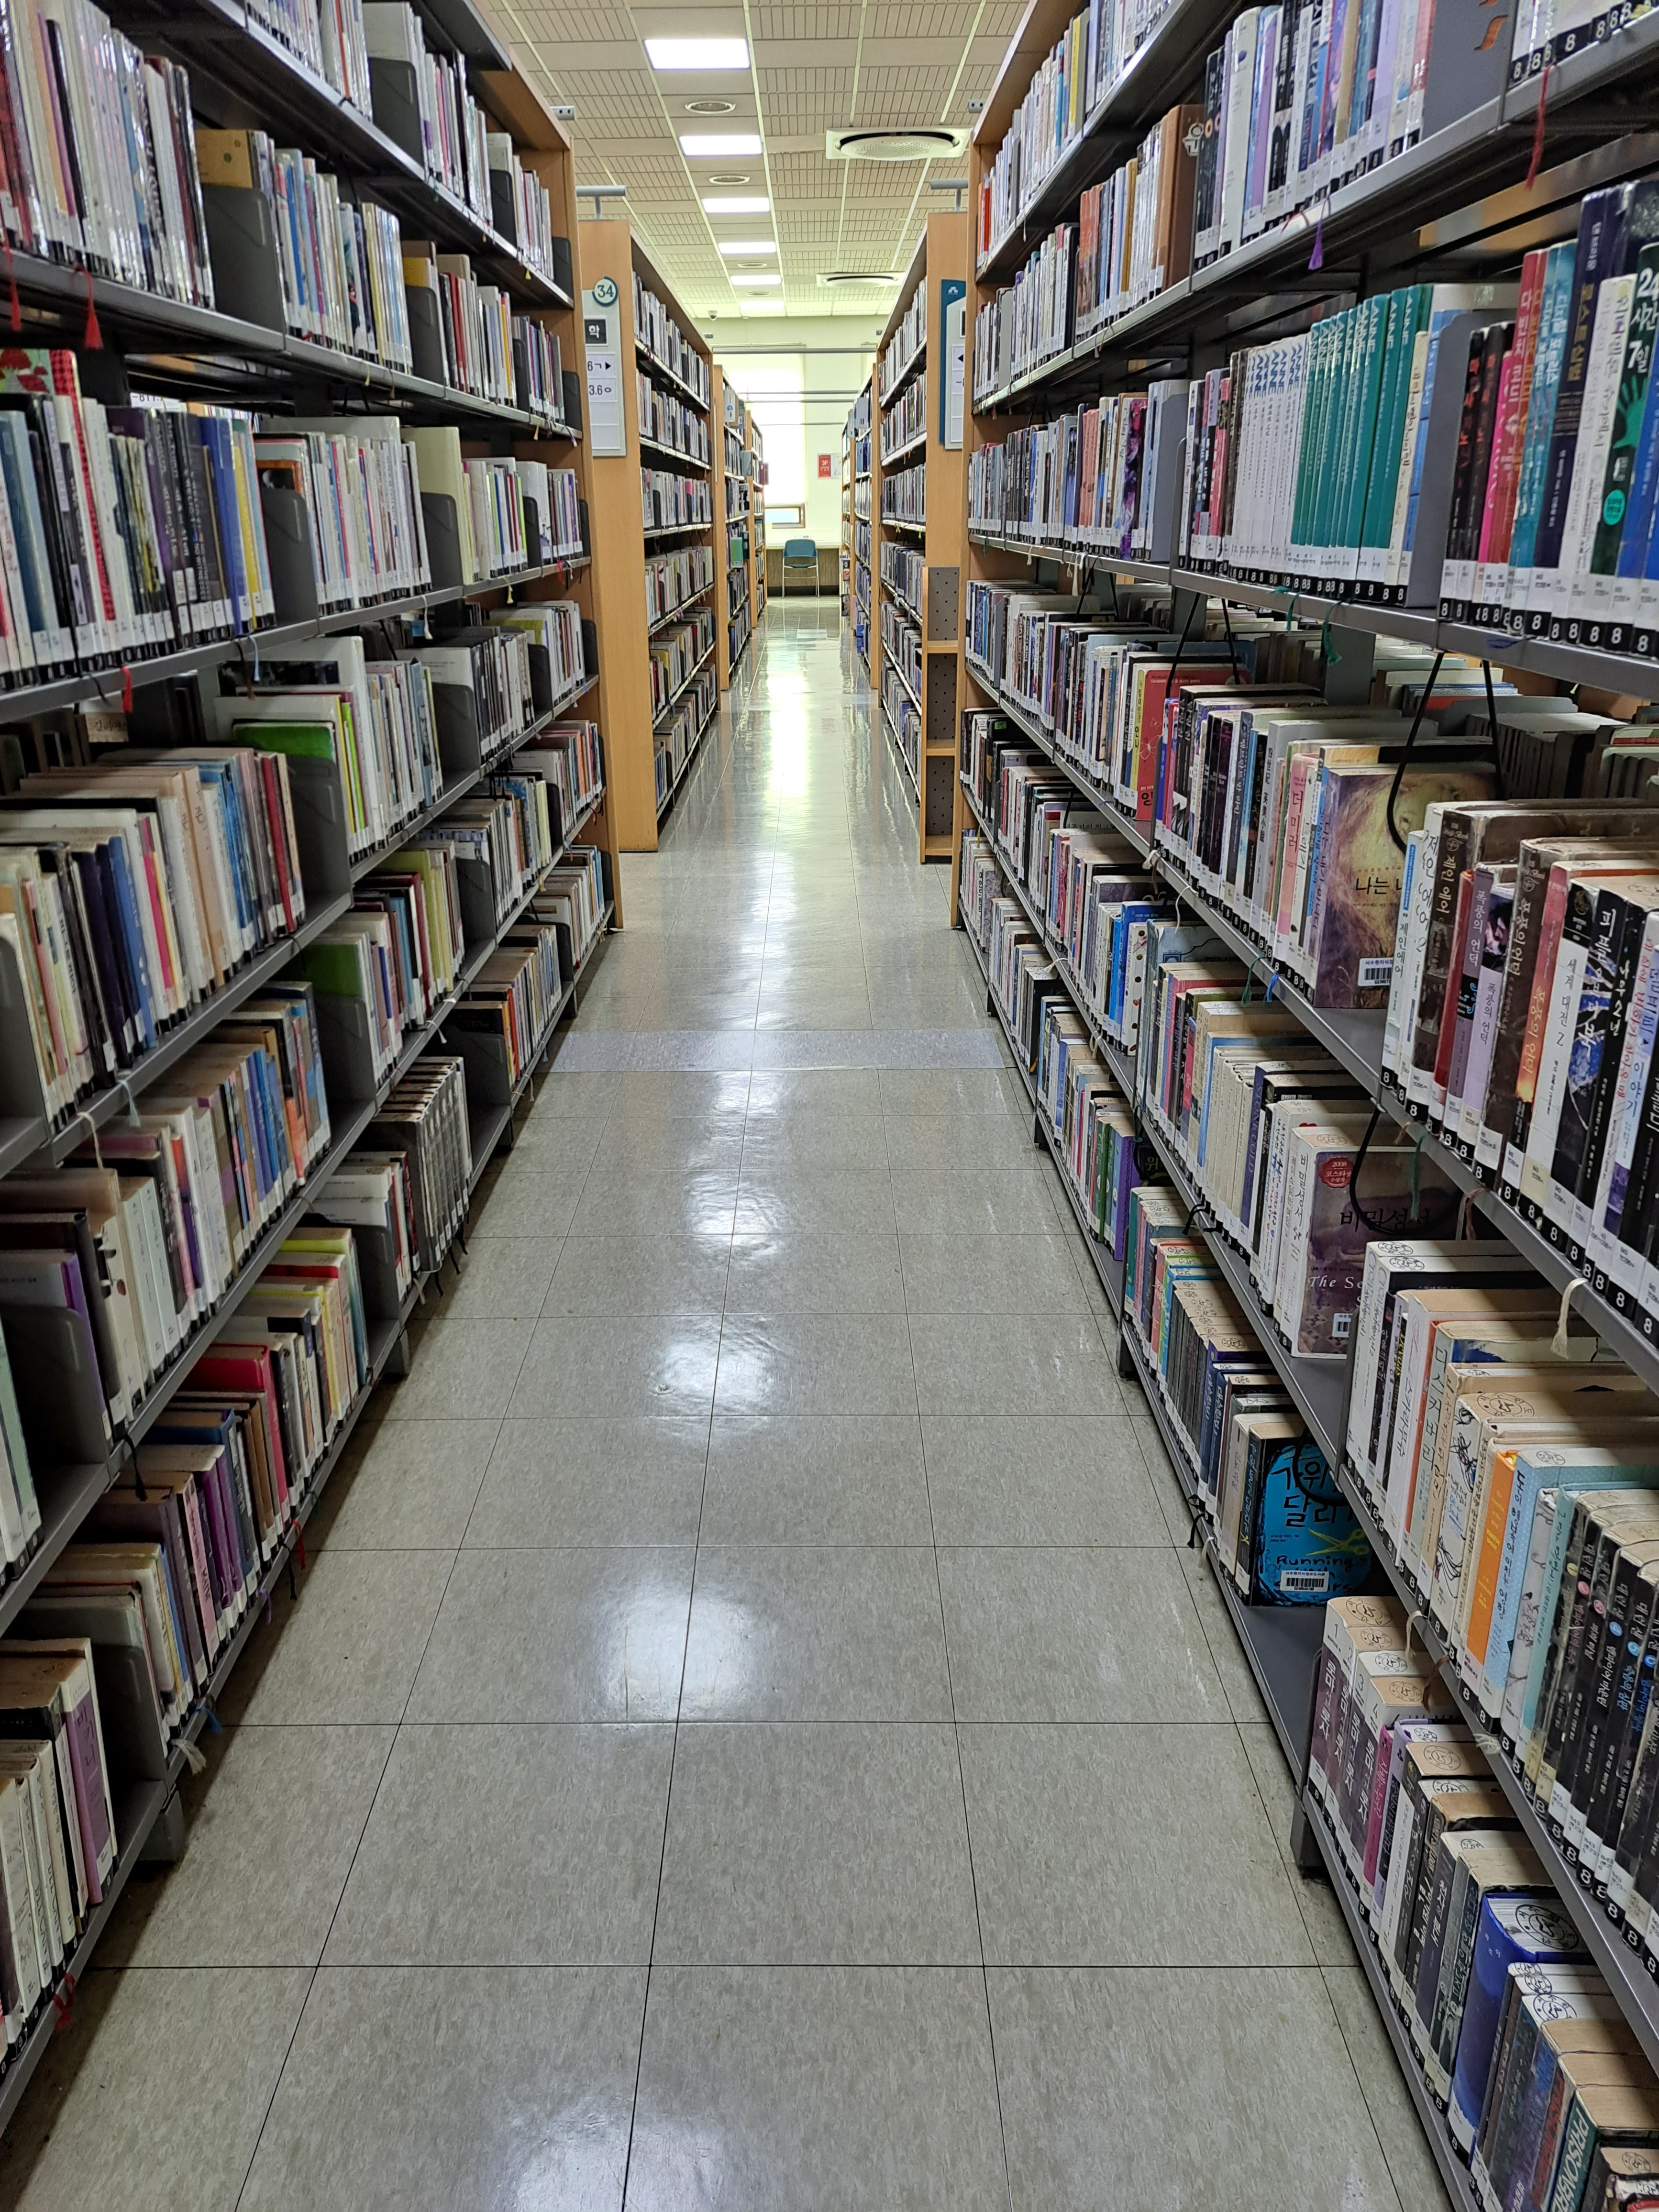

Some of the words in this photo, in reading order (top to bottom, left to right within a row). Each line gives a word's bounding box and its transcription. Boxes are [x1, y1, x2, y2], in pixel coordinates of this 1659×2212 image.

[1596, 21, 1605, 38] 8
[1609, 11, 1618, 29] 8
[1565, 33, 1576, 52] 8
[1514, 62, 1522, 79] 8
[1592, 221, 1602, 235] 댄
[597, 285, 614, 298] 34
[1636, 267, 1659, 301] 24
[1368, 305, 1379, 354] ANNE
[1387, 300, 1398, 349] ANNE
[1402, 296, 1413, 345] ANNE
[1552, 295, 1568, 333] 디지털
[1630, 301, 1658, 332] 시간
[588, 324, 600, 338] 학
[1334, 321, 1345, 365] ANNE
[1345, 318, 1354, 362] ANNE
[1310, 330, 1318, 371] ANNE
[1318, 325, 1328, 369] ANNE
[1546, 338, 1562, 384] 포트리스
[1627, 340, 1649, 374] 7일
[1254, 354, 1263, 398] ANNE
[1269, 350, 1279, 394] ANNE
[1277, 349, 1287, 394] ANNE
[1294, 343, 1302, 388] ANNE
[1532, 614, 1542, 630] 8
[1551, 623, 1559, 639] 8
[1590, 626, 1600, 642] 8
[1611, 627, 1622, 644] 8
[1637, 635, 1648, 652] 8
[1442, 855, 1456, 883] 제인
[1356, 876, 1389, 895] 나는
[1437, 886, 1452, 914] 에어
[1473, 890, 1487, 934] 폭풍의
[1513, 897, 1531, 946] 폭풍의
[1395, 922, 1409, 978] 제인에어
[1416, 937, 1427, 953] 2
[1593, 908, 1616, 964] 피플
[1469, 939, 1481, 967] 언덕
[1564, 959, 1578, 991] 세계
[1483, 983, 1500, 1018] 폭풍의
[1528, 985, 1547, 1039] 폭풍의
[1558, 995, 1572, 1028] 대전
[1480, 1021, 1490, 1045] 언덕
[1626, 1062, 1644, 1118] 이야기
[1309, 1275, 1337, 1288] The
[1643, 1317, 1652, 1334] 8
[1395, 1333, 1407, 1377] Devdas
[1396, 1376, 1413, 1458] 스카라무슈
[1277, 1555, 1354, 1571] Running
[1583, 1544, 1596, 1567] 대런
[1614, 1583, 1629, 1607] 대런
[1633, 1602, 1648, 1626] 대런
[1334, 1624, 1338, 1639] 1
[1601, 1646, 1616, 1681] 뱀파이어
[1358, 1673, 1364, 1692] 3
[1372, 1703, 1378, 1719] 4
[1373, 1787, 1382, 1818] 누구?
[1627, 1930, 1638, 1946] 8
